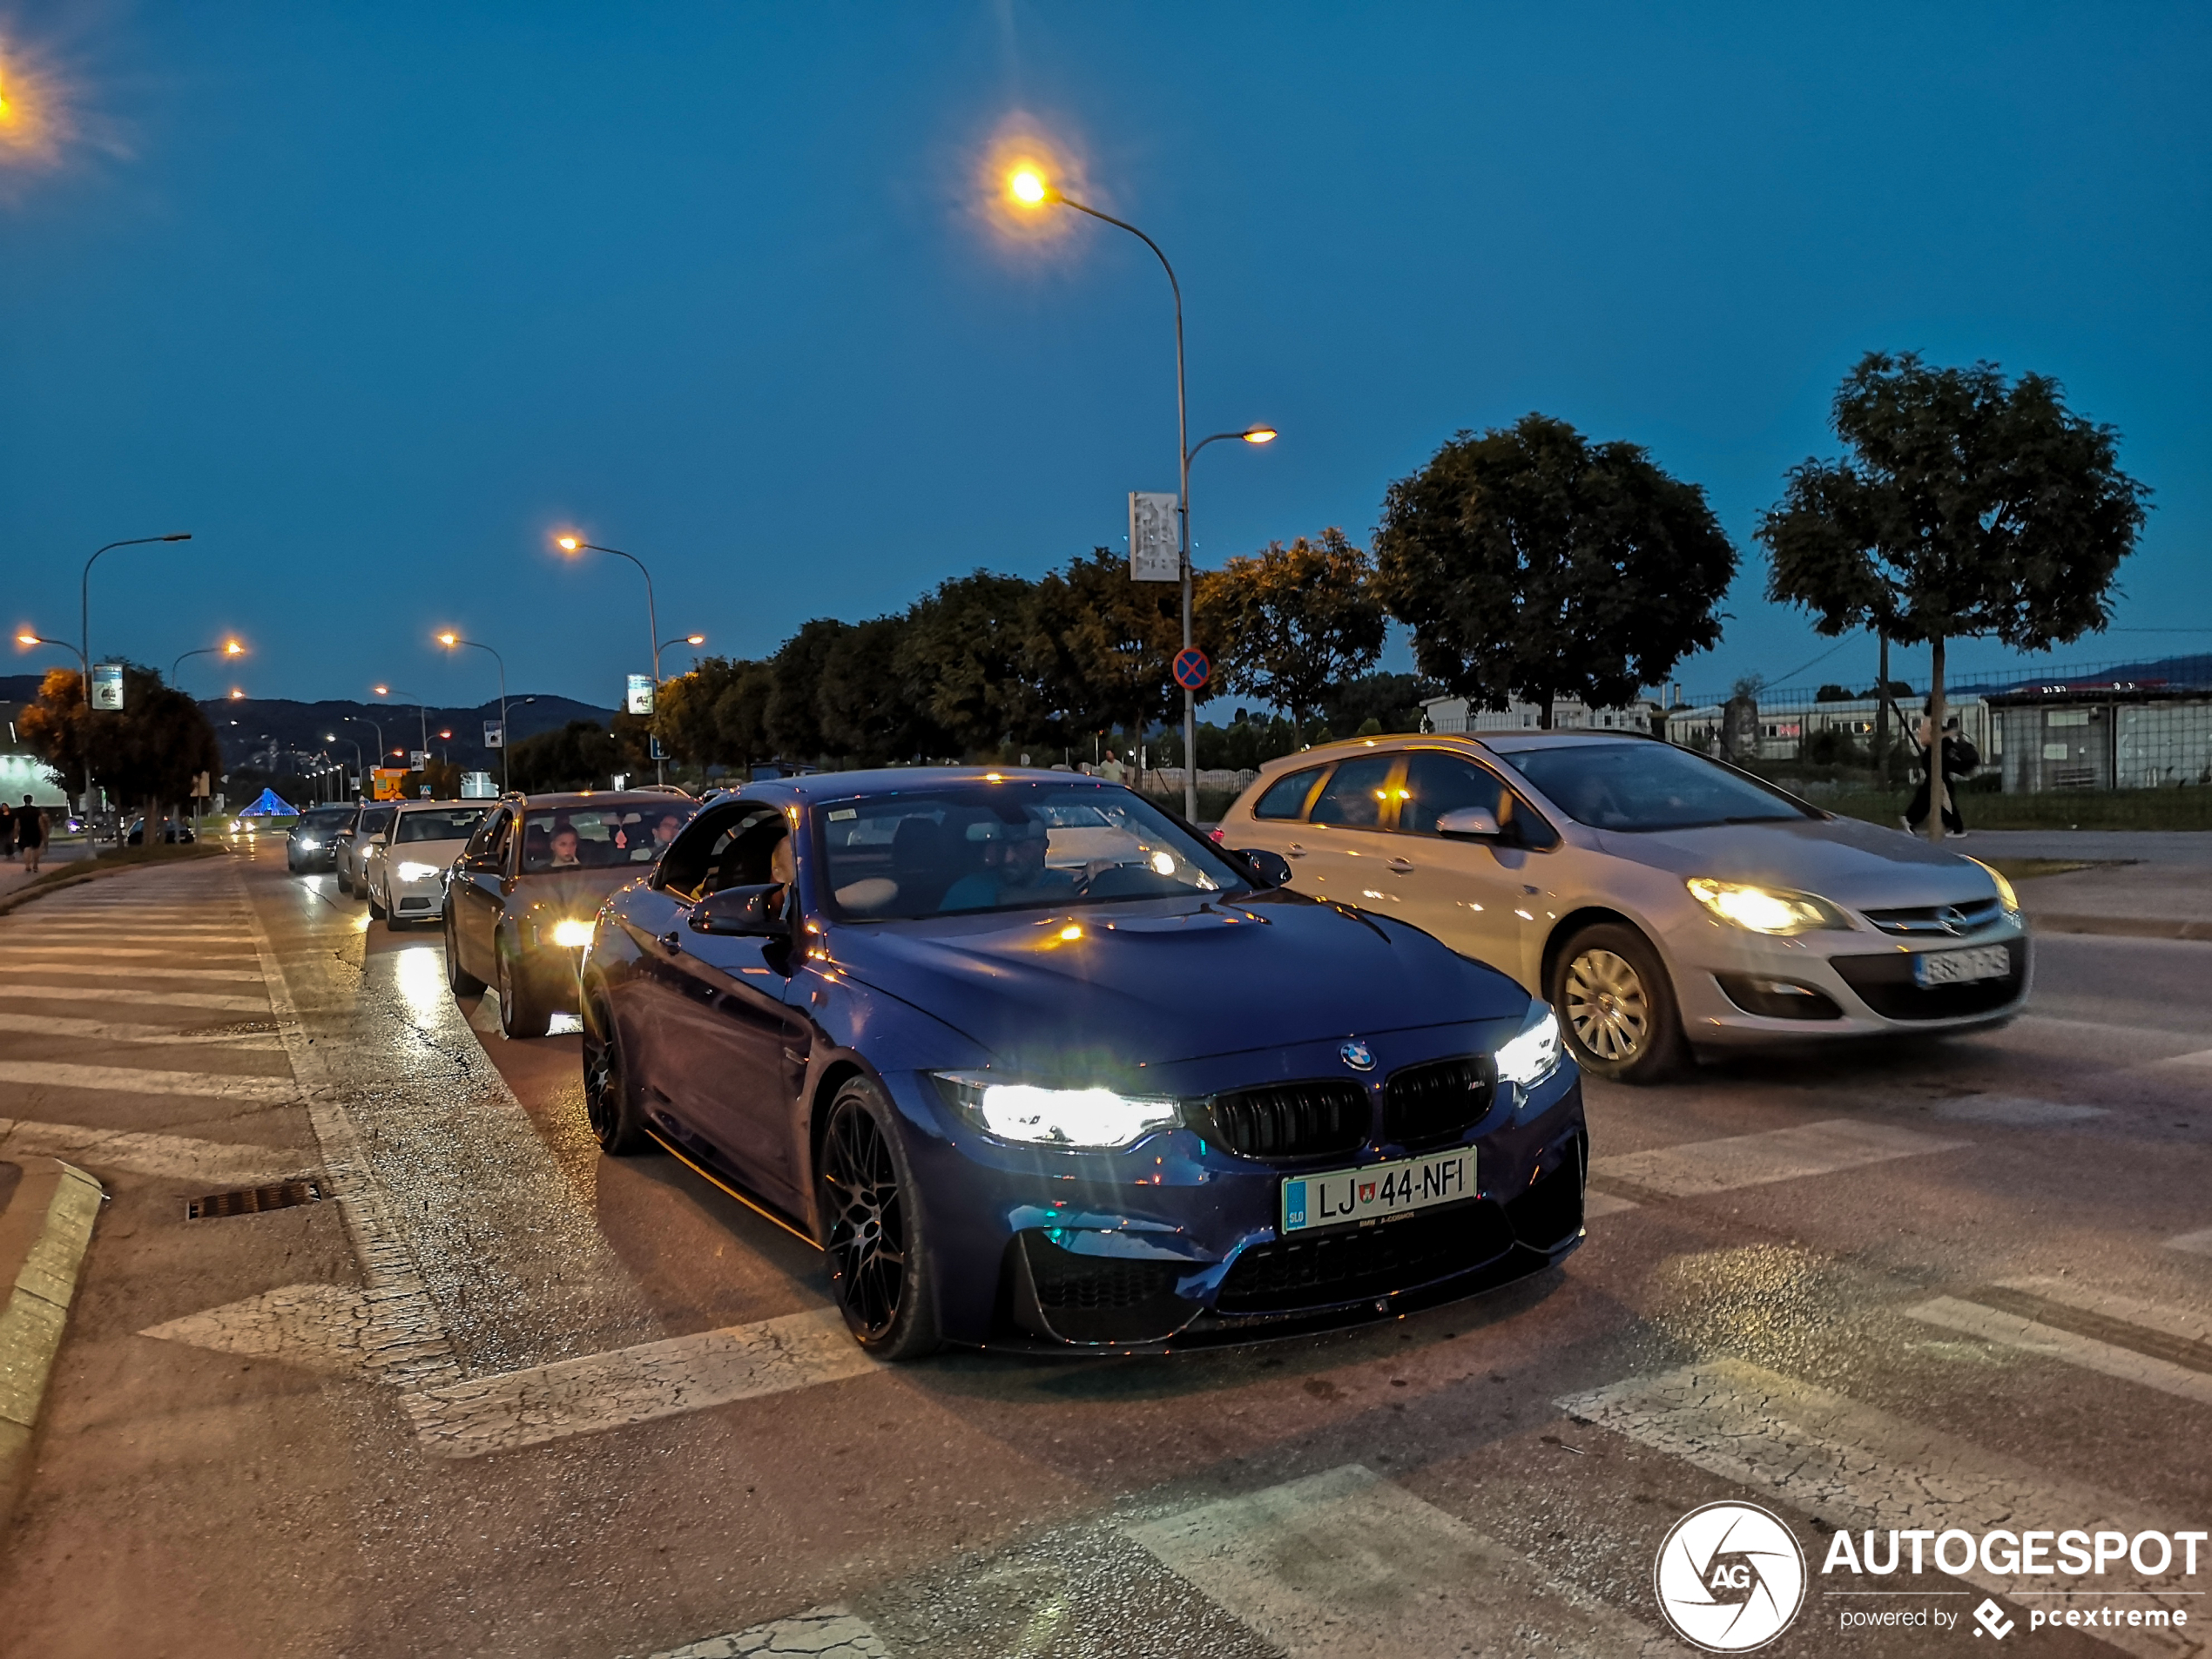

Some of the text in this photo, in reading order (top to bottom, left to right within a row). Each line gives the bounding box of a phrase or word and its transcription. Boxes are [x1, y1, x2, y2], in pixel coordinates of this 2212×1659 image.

[1319, 1157, 1463, 1218] LJ 44-NFI
[1289, 1211, 1304, 1224] SLO
[1359, 1218, 1376, 1228] BMW
